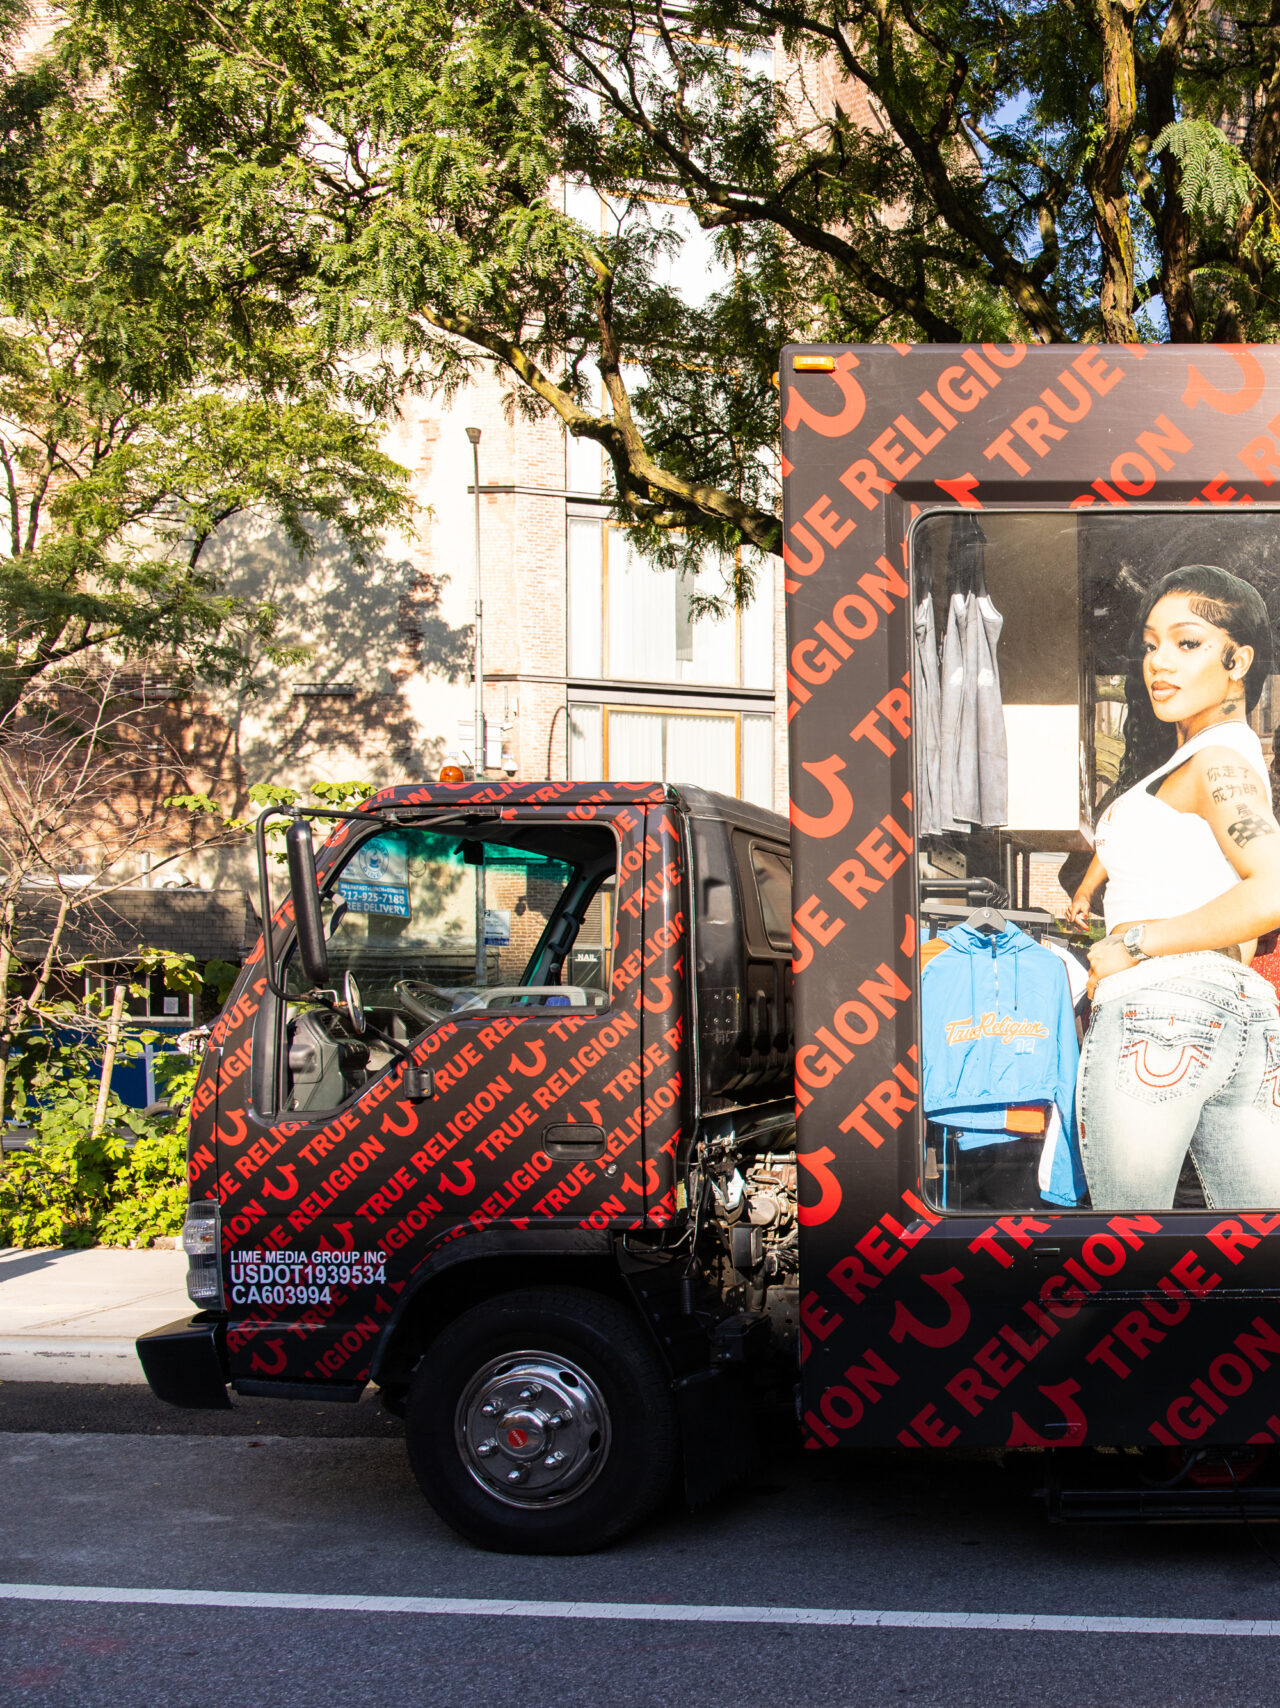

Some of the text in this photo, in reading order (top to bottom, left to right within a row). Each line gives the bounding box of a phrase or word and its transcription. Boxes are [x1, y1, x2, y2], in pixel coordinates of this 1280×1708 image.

[983, 345, 1126, 478] TRUE
[783, 493, 858, 595] UE
[838, 343, 1040, 511] RELIGIO
[849, 671, 912, 758] TR
[346, 901, 406, 915] REE DELIVERY
[207, 993, 260, 1052] TRUE
[794, 962, 913, 1120] IGION
[945, 1011, 1050, 1047] True Religion
[433, 1042, 484, 1101] RUE
[475, 1102, 539, 1161] TRUE
[532, 1010, 638, 1110] RELIGION
[602, 1042, 670, 1102] TRUE
[234, 1121, 310, 1180] RELIG
[297, 1107, 361, 1167] TRUE
[355, 1075, 514, 1224] TRUE RELIGION
[286, 1134, 387, 1231] RELIGION
[532, 1161, 597, 1219] TRUE
[230, 1251, 387, 1264] LIME MEDIA GROUP INC
[230, 1265, 387, 1285] USDOT1939534
[232, 1286, 332, 1305] CA603994
[944, 1215, 1163, 1417] RELIGION
[1085, 1250, 1223, 1379] TRUE
